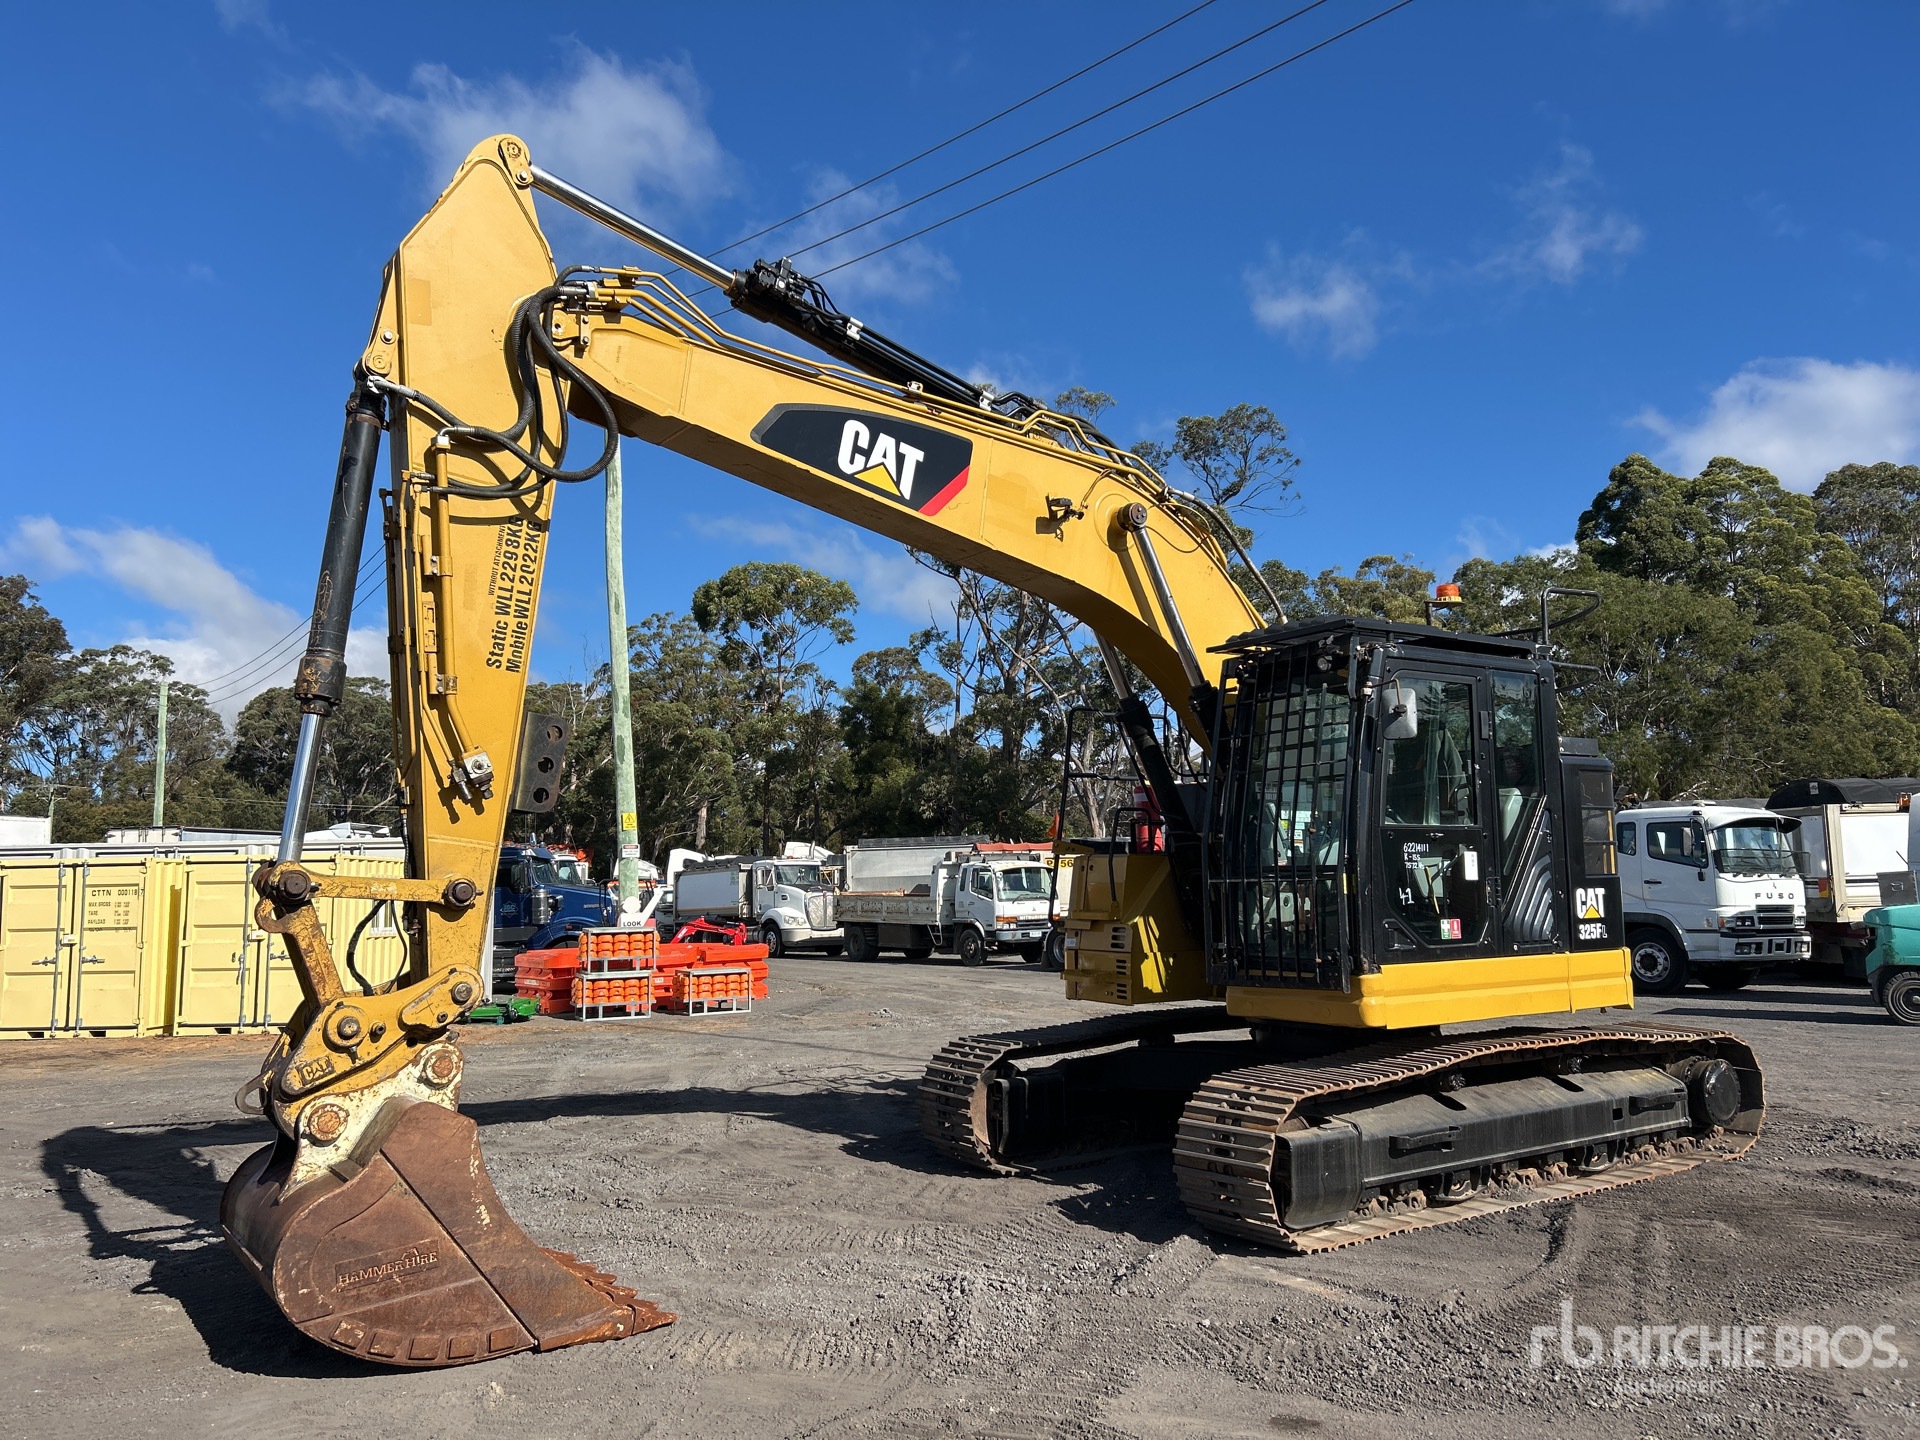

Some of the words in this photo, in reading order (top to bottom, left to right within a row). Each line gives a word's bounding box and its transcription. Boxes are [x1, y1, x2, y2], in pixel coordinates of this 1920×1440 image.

[837, 419, 925, 501] CAT
[486, 620, 509, 670] Static
[505, 620, 529, 673] Mobile
[91, 889, 112, 897] CTTN
[1399, 887, 1415, 905] 41
[1576, 887, 1606, 919] CAT
[1754, 892, 1795, 900] FUSO
